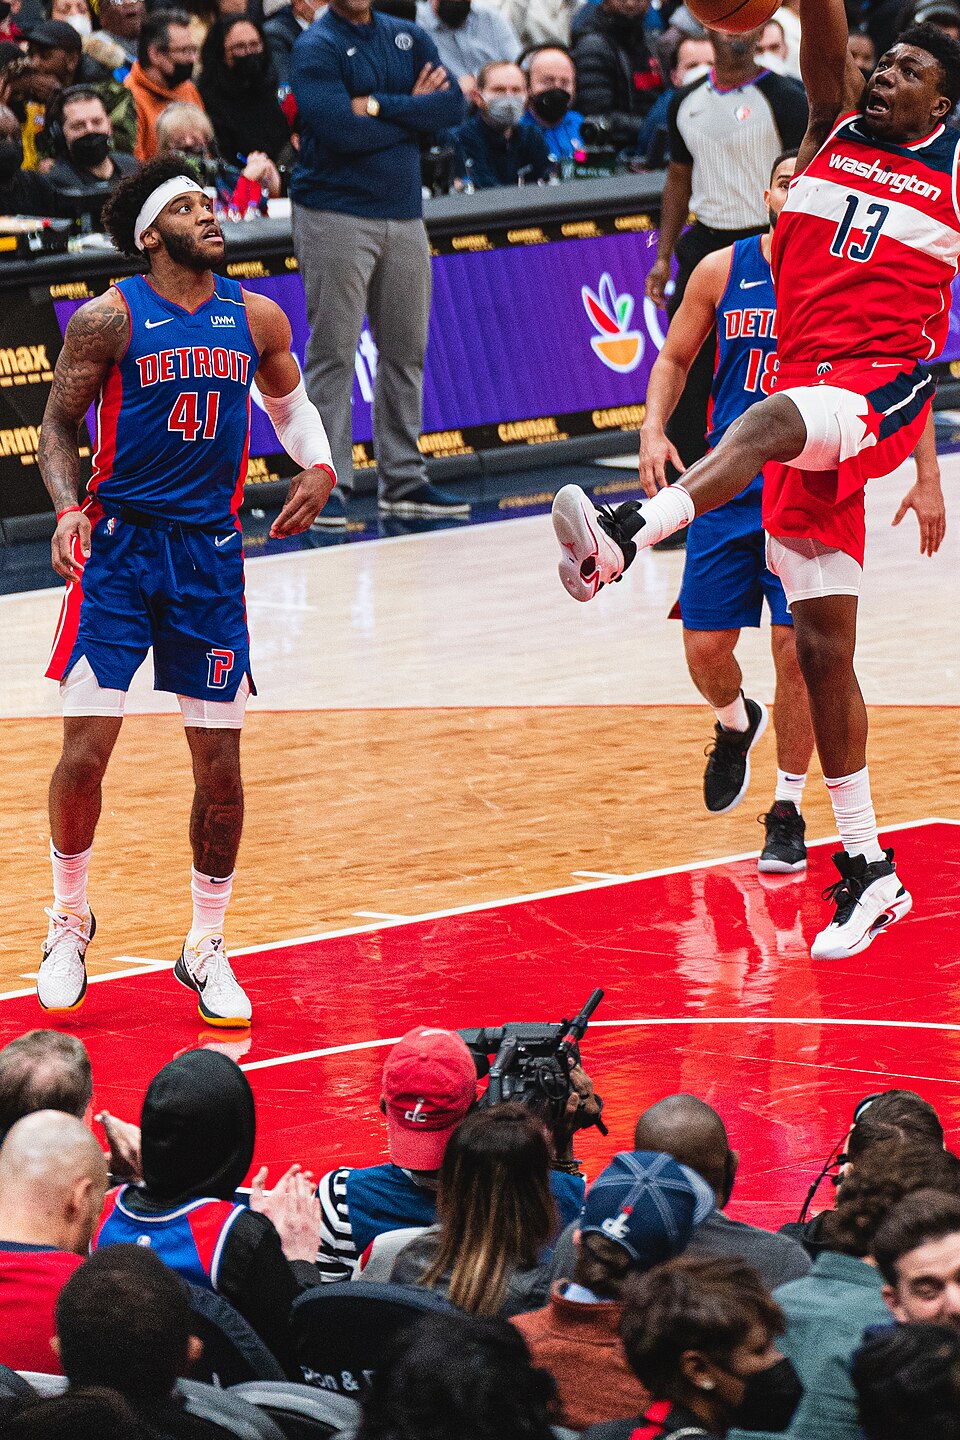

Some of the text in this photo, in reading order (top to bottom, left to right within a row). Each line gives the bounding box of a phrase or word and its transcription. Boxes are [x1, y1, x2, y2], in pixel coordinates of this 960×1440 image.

[829, 153, 942, 202] washington
[830, 194, 890, 263] 13
[210, 315, 236, 326] UWM
[136, 346, 251, 388] DETROIT
[744, 349, 780, 396] 18
[168, 391, 221, 441] 41
